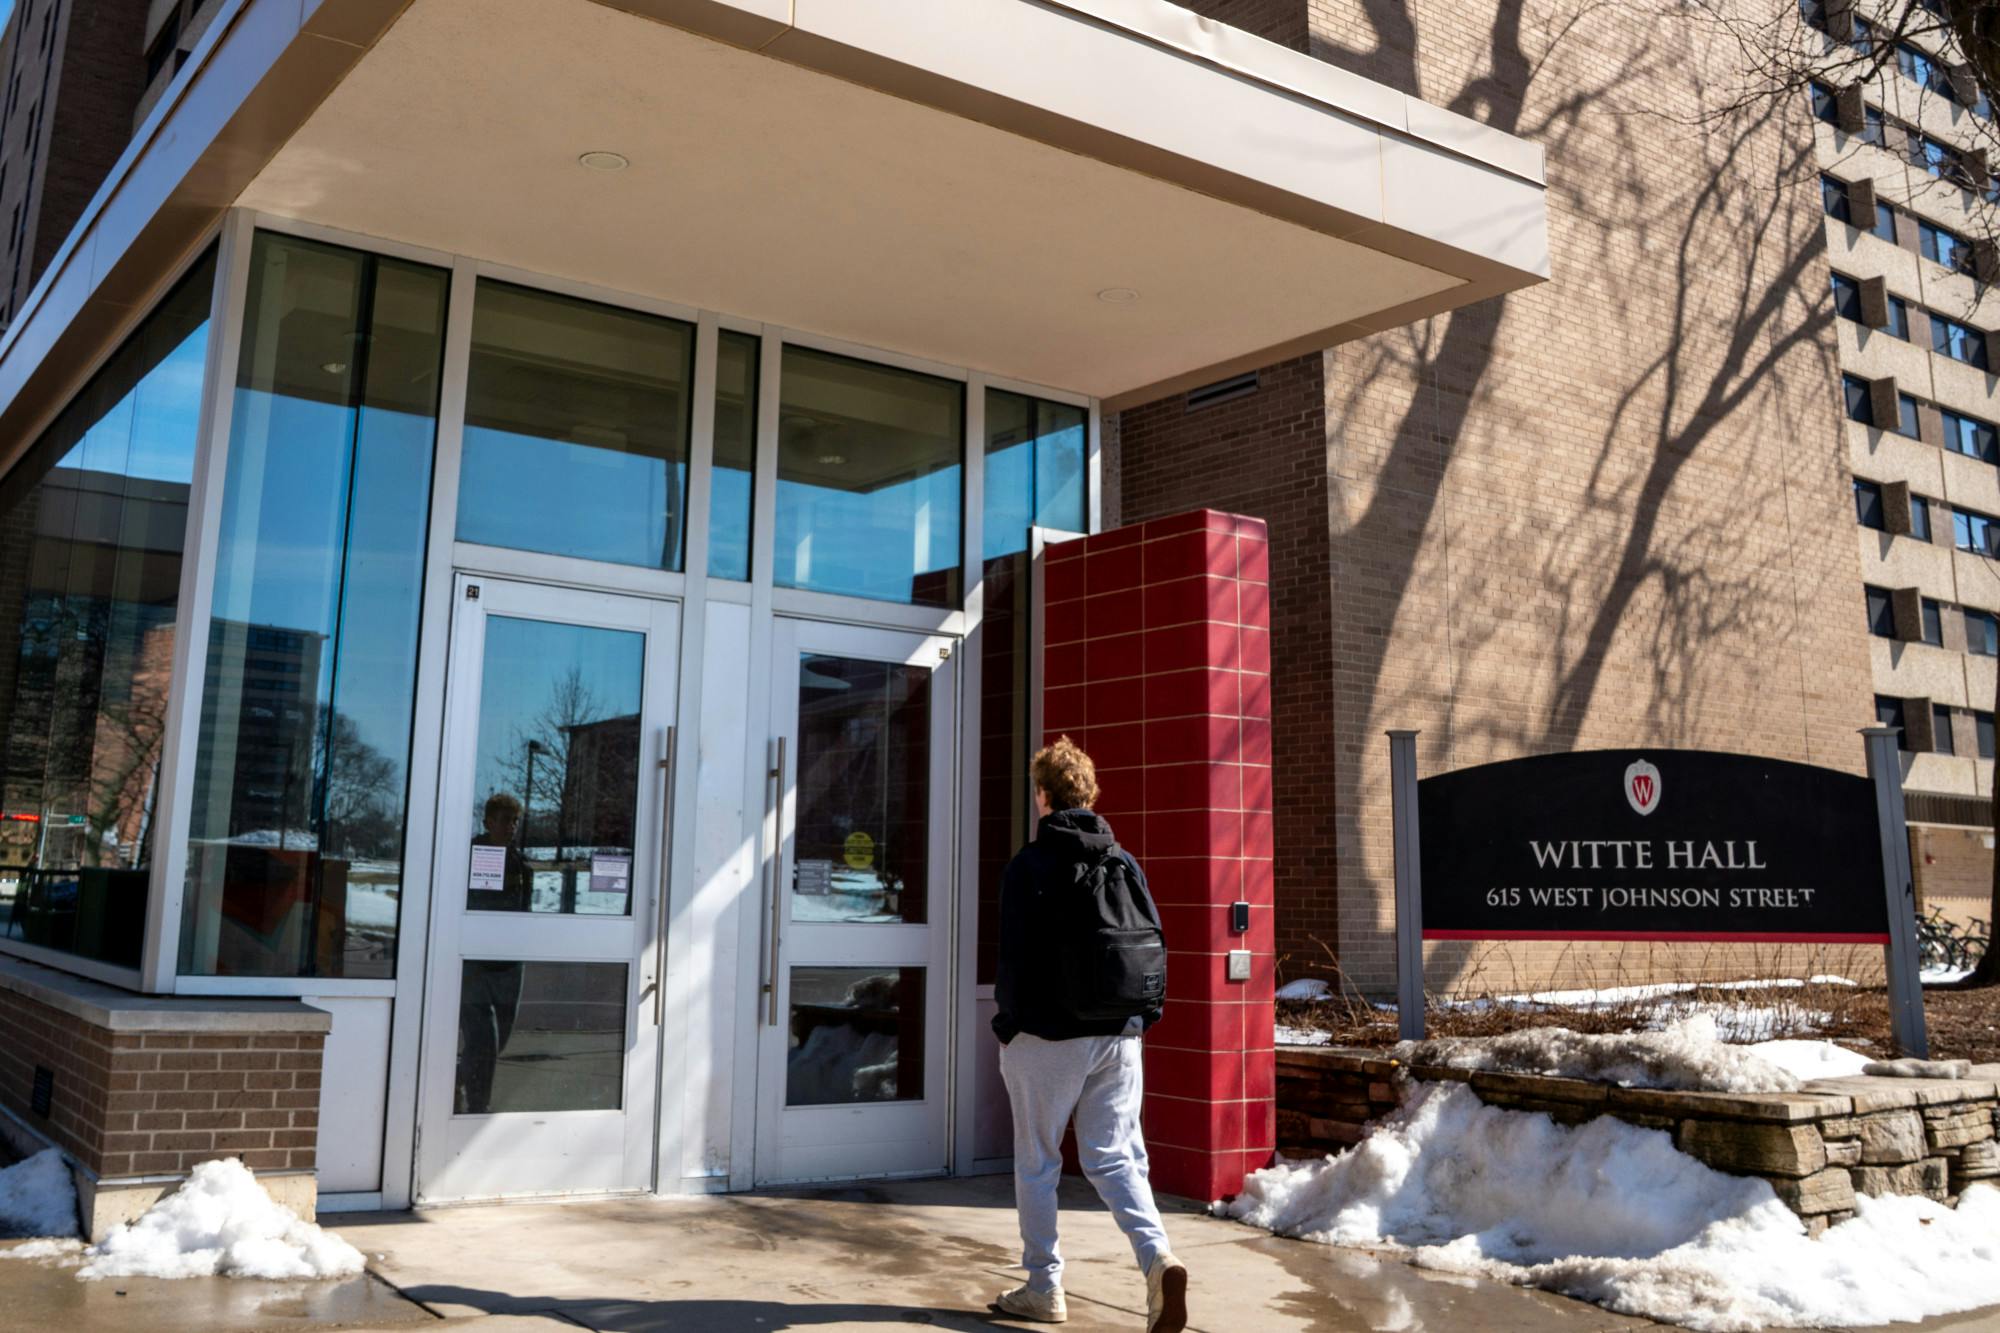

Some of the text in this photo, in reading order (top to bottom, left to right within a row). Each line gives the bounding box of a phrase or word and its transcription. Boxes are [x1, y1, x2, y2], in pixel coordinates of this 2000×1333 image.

[1634, 778, 1652, 803] W
[1529, 840, 1767, 869] WITTE HALL
[1486, 887, 1816, 911] 615 WEST JOHNSON STREET
